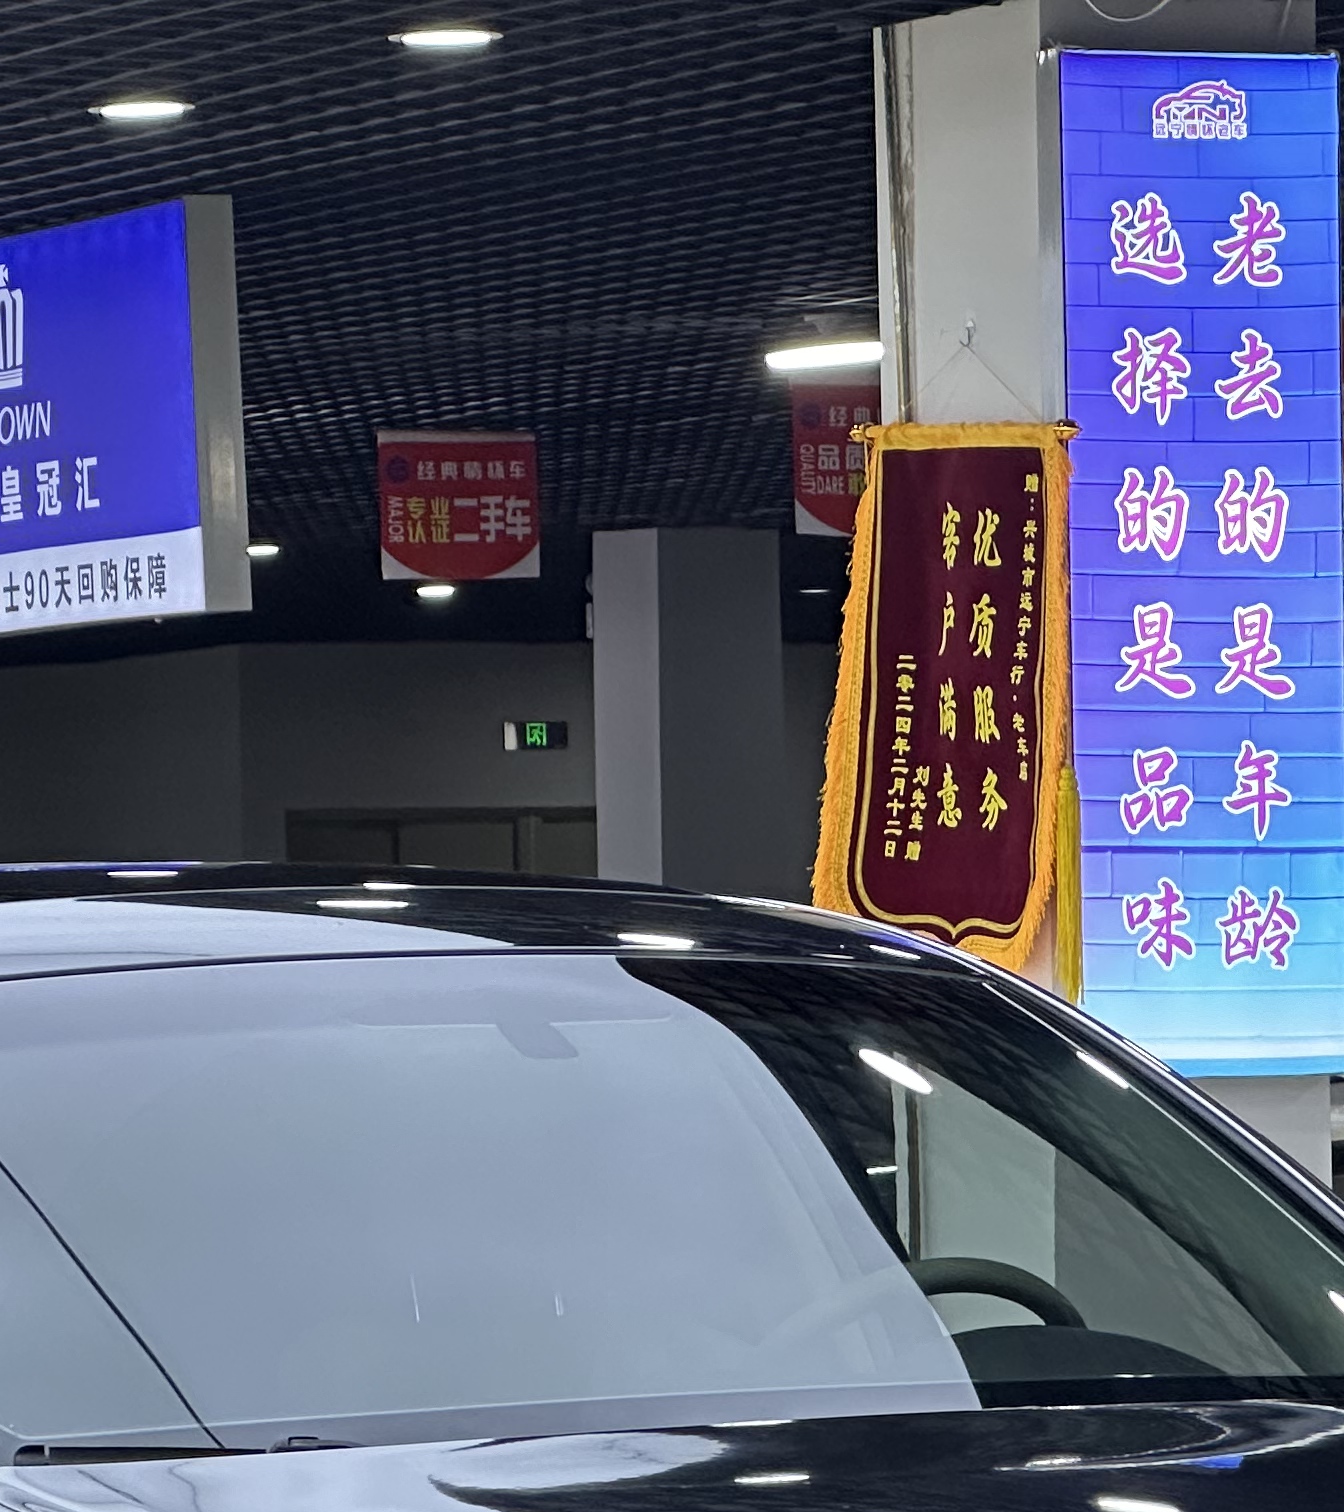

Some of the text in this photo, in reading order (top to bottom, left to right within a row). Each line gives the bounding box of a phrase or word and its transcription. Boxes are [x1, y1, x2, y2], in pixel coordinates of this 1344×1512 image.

[828, 405, 880, 427] 经典
[386, 496, 405, 544] MAJOR
[406, 495, 451, 519] 专业
[406, 519, 452, 544] 认证
[453, 494, 533, 544] 二手车
[1111, 191, 1195, 969] 选择的是品味
[1212, 191, 1299, 970] 老去的是年龄
[936, 501, 964, 830] 客户满意
[969, 506, 1009, 833] 优质服务
